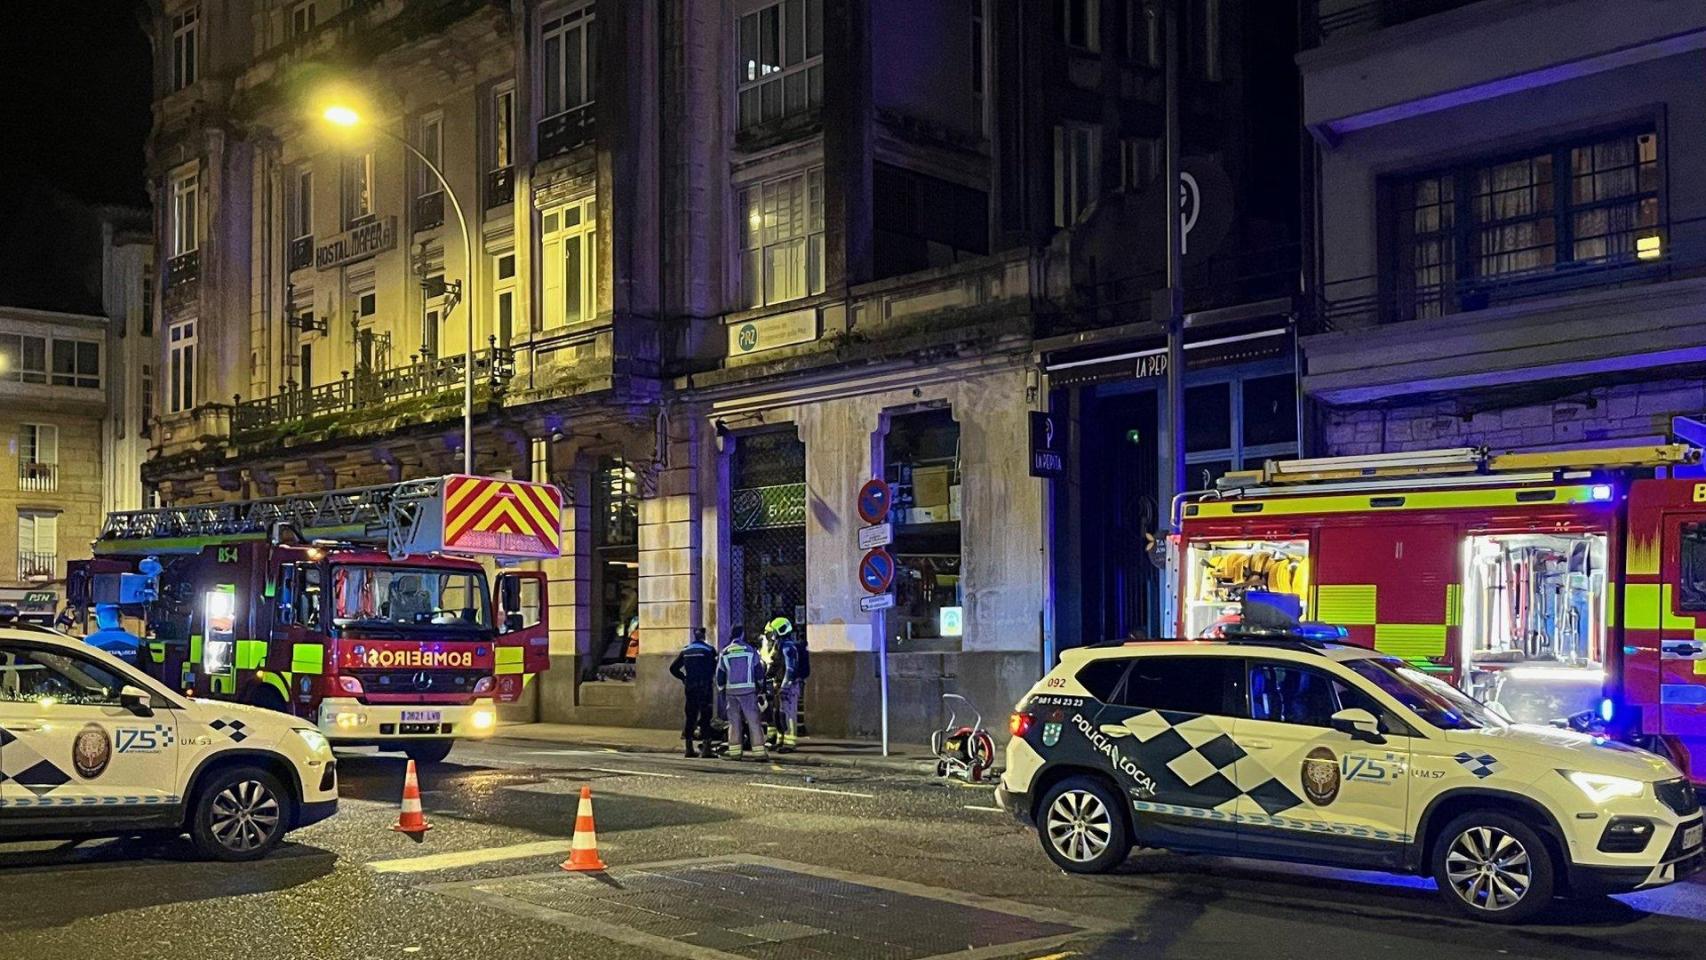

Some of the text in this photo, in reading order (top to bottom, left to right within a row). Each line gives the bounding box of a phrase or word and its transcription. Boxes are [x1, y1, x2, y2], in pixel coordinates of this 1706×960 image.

[316, 239, 350, 267] HOSTAL
[1136, 358, 1147, 378] LA
[1148, 355, 1168, 376] PEP
[218, 547, 238, 563] BS-4
[1047, 678, 1066, 688] 092
[1062, 698, 1073, 706] 23
[1073, 698, 1084, 707] 23
[115, 729, 157, 753] 175
[1119, 756, 1158, 796] LOCAL
[1342, 755, 1386, 781] 175
